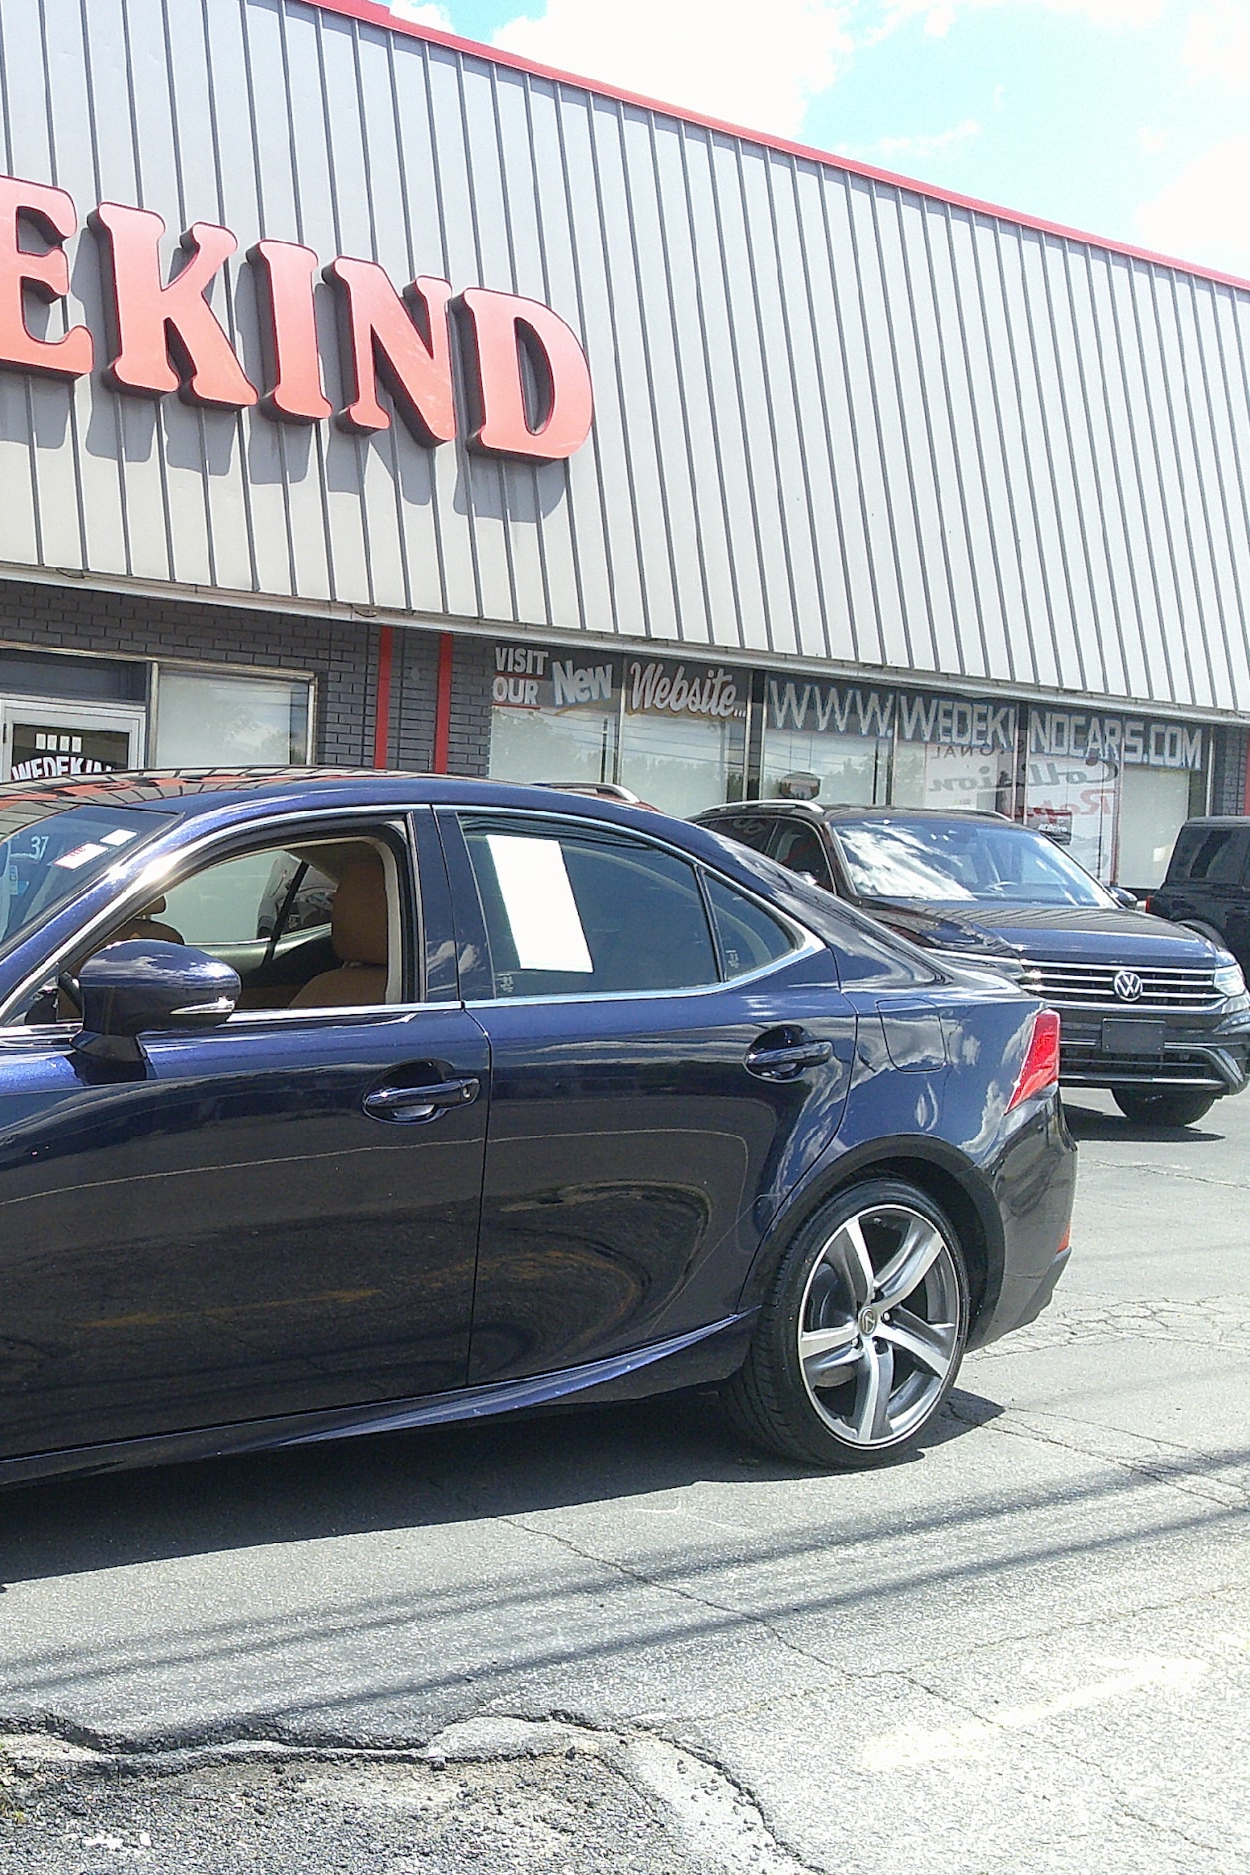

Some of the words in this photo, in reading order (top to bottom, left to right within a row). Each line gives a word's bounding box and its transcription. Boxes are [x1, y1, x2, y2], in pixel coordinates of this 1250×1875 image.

[495, 647, 548, 676] VISIT
[492, 676, 539, 706] OUR
[552, 659, 613, 707] New
